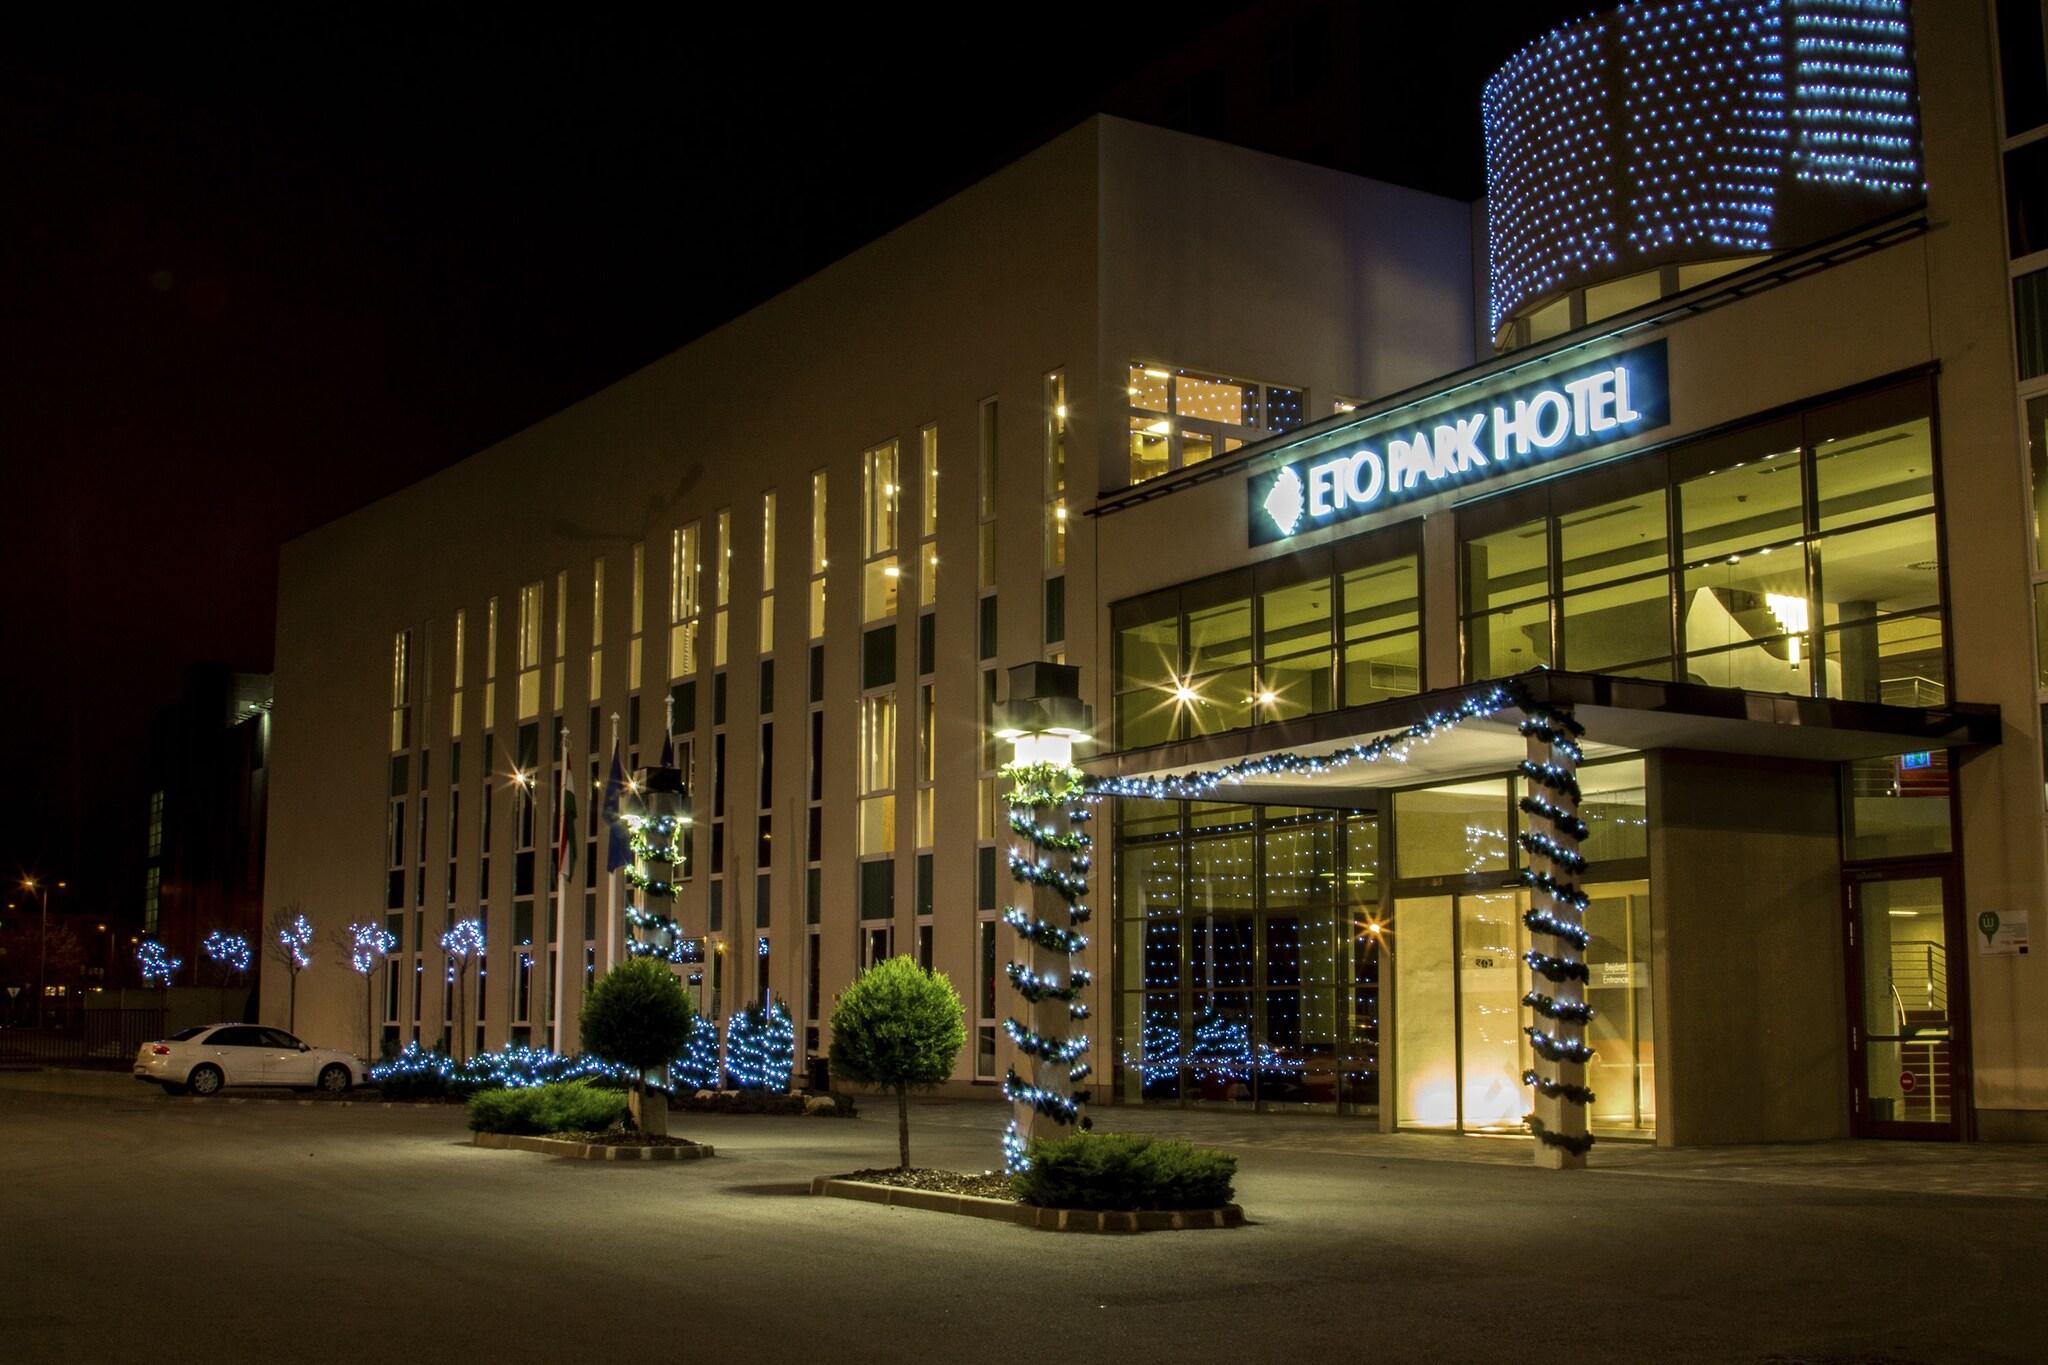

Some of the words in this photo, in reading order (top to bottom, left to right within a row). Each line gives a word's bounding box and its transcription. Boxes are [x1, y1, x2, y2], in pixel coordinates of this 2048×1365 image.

[1310, 451, 1384, 516] ETO
[1388, 413, 1489, 492] PARK
[1494, 367, 1640, 460] HOTEL
